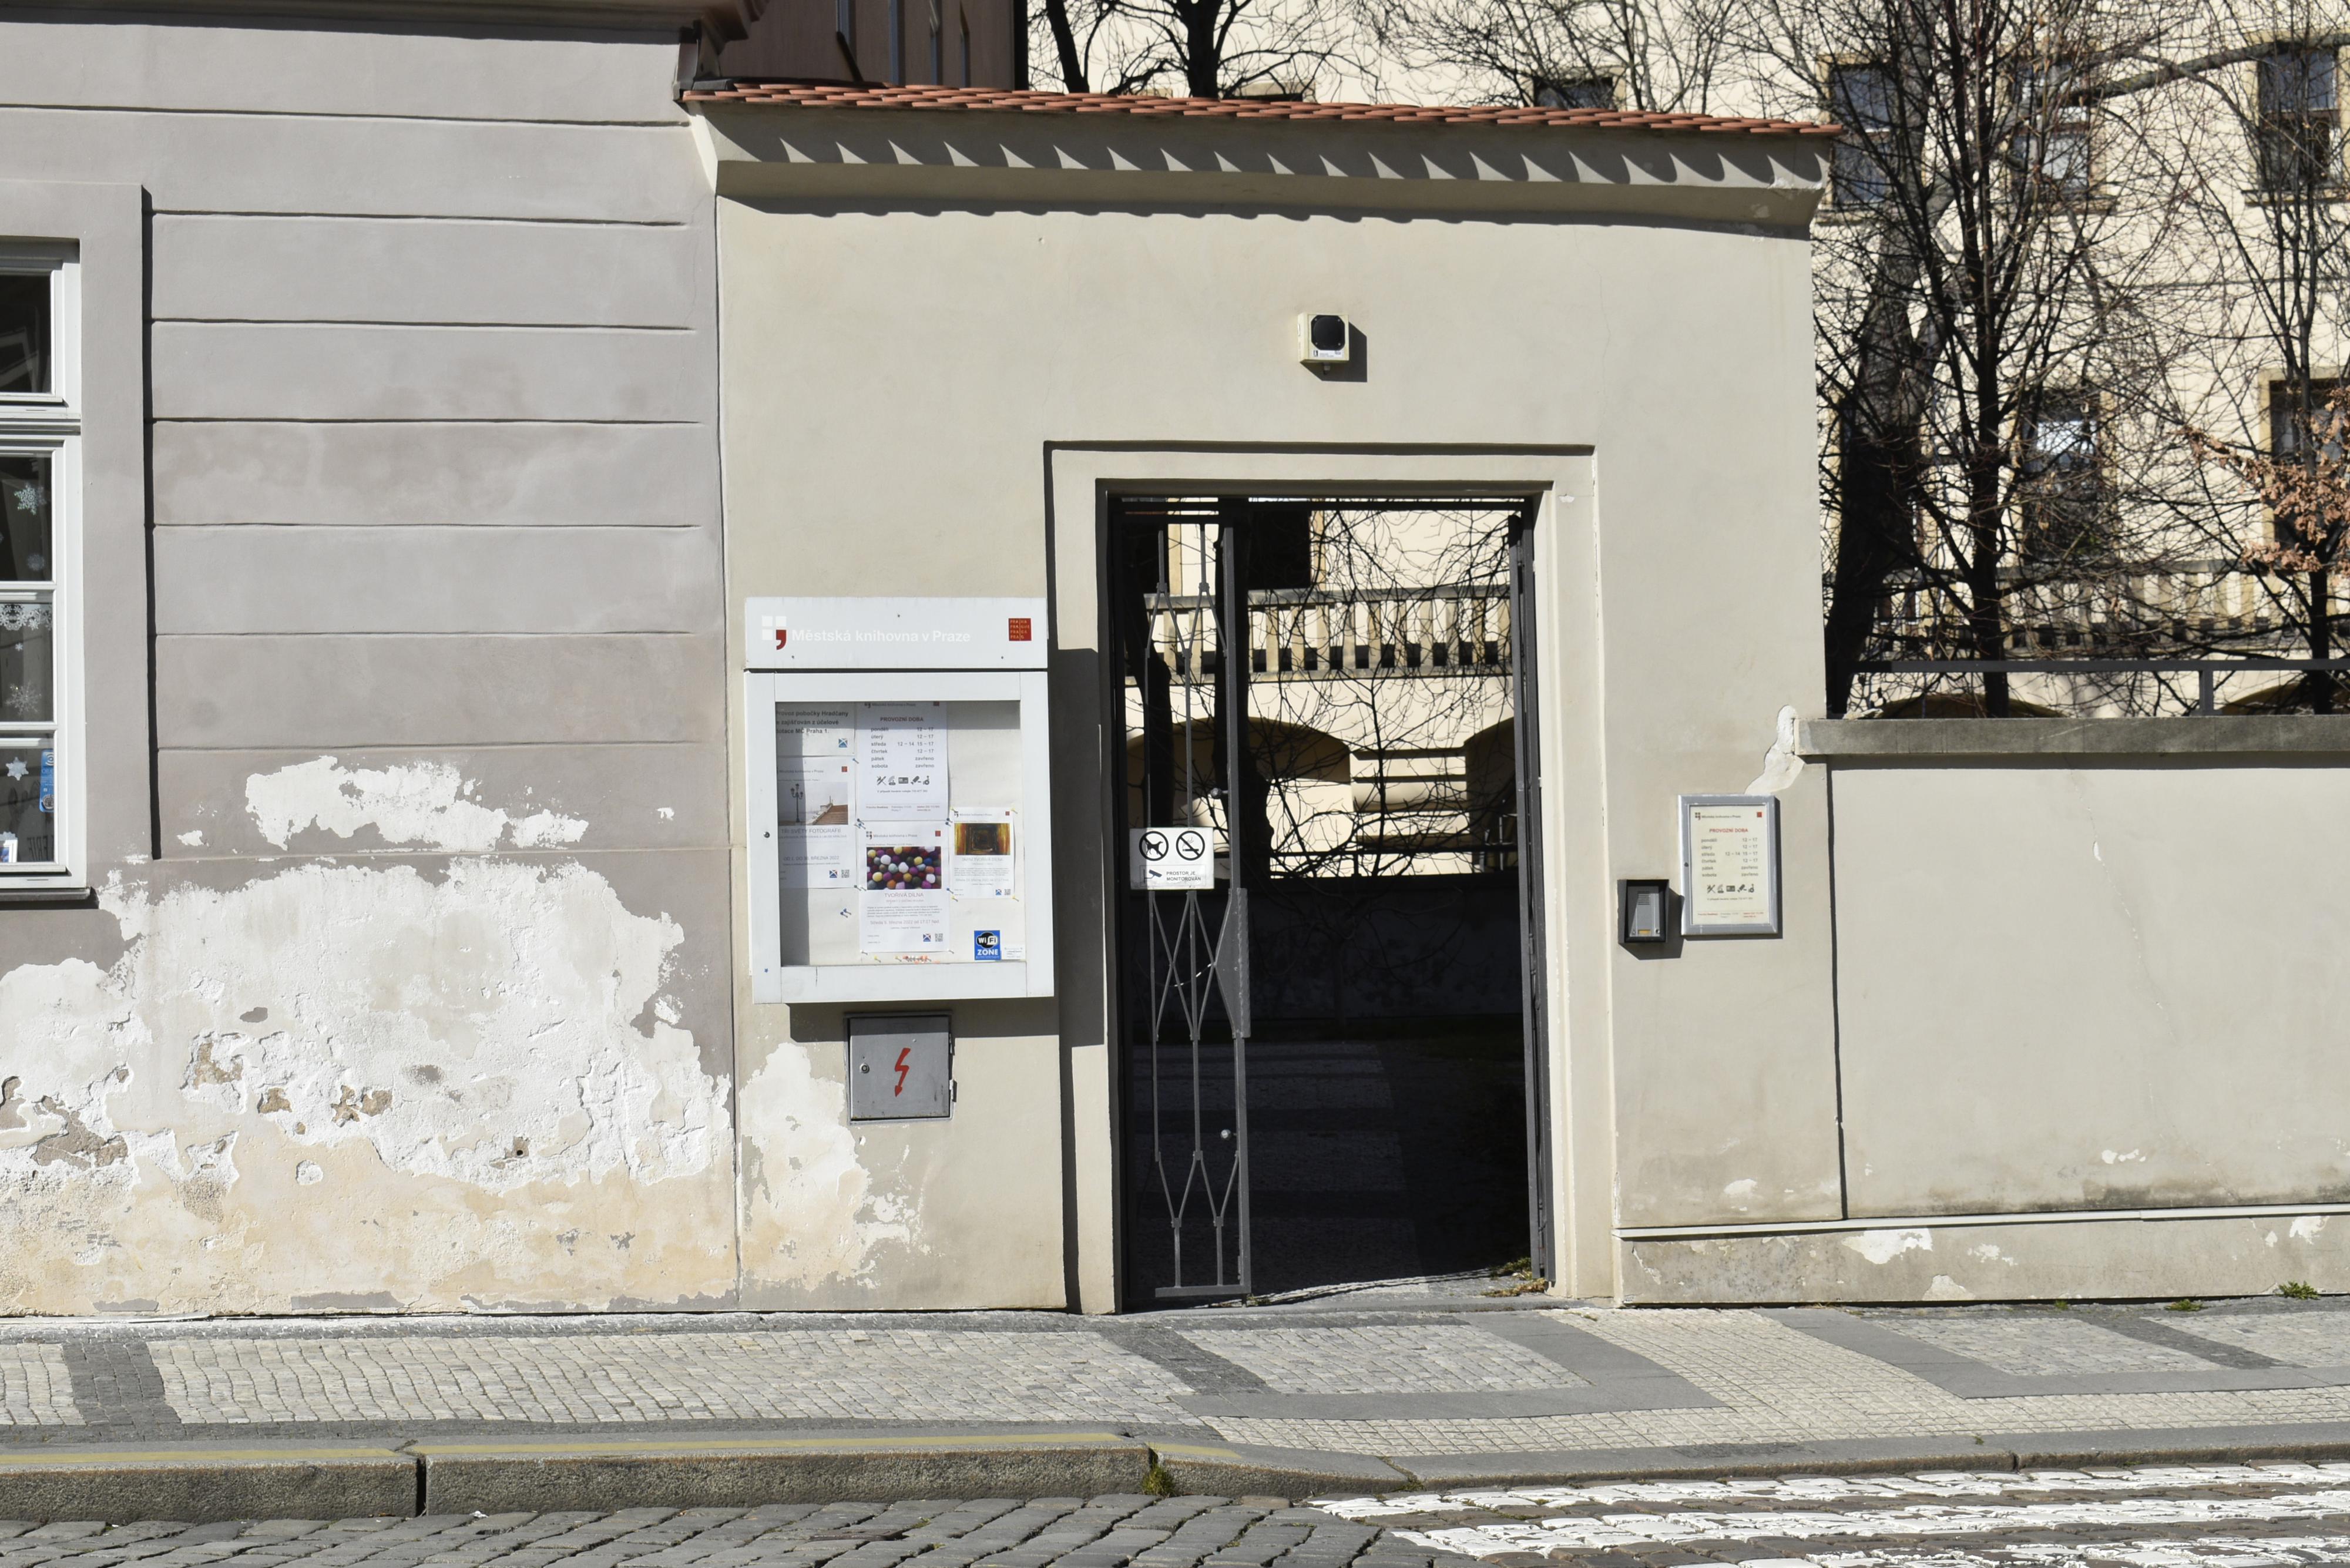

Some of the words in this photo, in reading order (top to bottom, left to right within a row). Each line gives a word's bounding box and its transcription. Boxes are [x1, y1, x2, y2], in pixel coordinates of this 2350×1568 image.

[792, 629, 851, 642] Městská
[856, 629, 918, 642] knihovna
[922, 633, 929, 642] v
[933, 630, 971, 642] Praze
